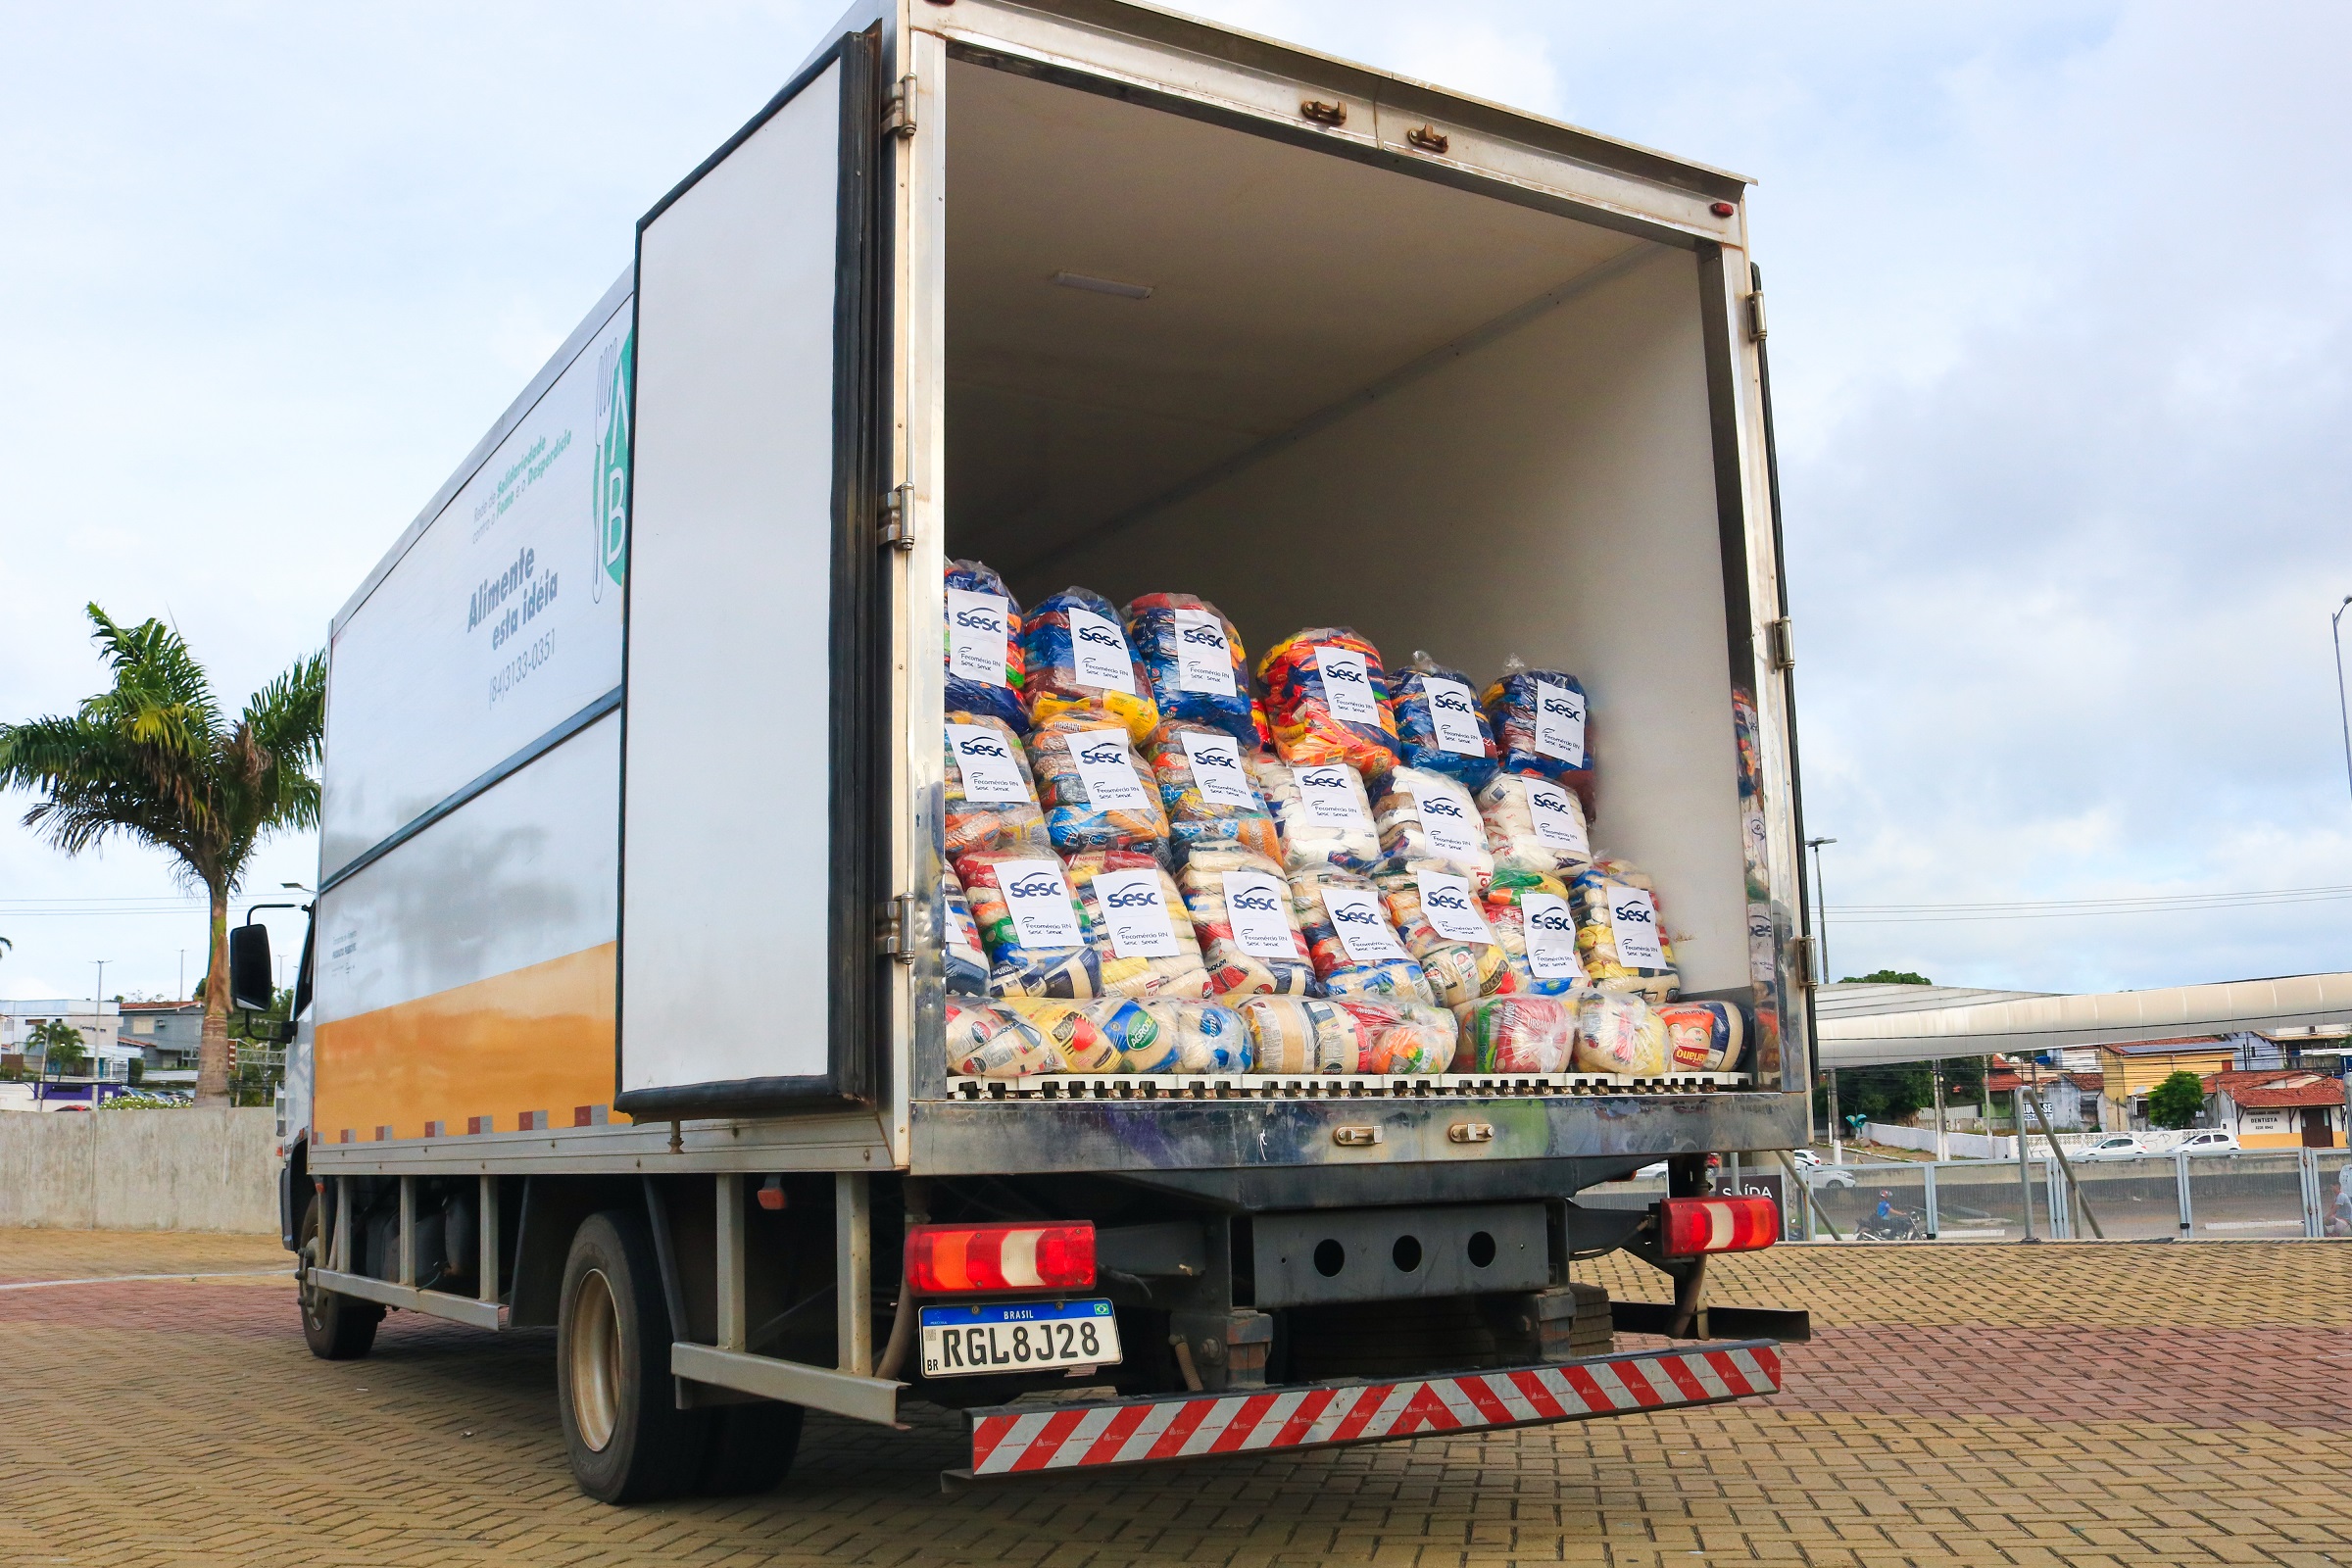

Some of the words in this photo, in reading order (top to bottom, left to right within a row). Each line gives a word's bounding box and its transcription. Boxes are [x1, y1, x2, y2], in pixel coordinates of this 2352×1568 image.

[466, 546, 535, 634] Alimente
[492, 608, 518, 651] esta
[522, 568, 559, 625] idéia
[956, 610, 1002, 633] Sesc
[1079, 627, 1122, 650] Sesc
[1184, 627, 1224, 649] Sesc
[489, 627, 556, 710] (84)3133-0351
[1326, 663, 1365, 684] Sesc
[1435, 693, 1470, 713] Sesc
[1544, 699, 1581, 722] Sesc
[960, 739, 1007, 758] Sesc
[1081, 747, 1125, 764] Sesc
[1195, 751, 1236, 769] Sesc
[1302, 772, 1347, 788] Sesc
[1423, 799, 1463, 818] Sesc
[1534, 793, 1568, 814] Sesc
[1009, 877, 1061, 898] Sesc
[1107, 888, 1157, 907] Sesc
[1233, 891, 1277, 910] Sesc
[1428, 889, 1468, 909] Sesc
[1335, 906, 1379, 925] Sesc
[1532, 910, 1570, 930] Sesc
[1616, 905, 1650, 923] Sesc
[1004, 1309, 1034, 1320] BRASIL
[943, 1322, 1100, 1367] RGL8J28
[927, 1358, 939, 1371] BR
